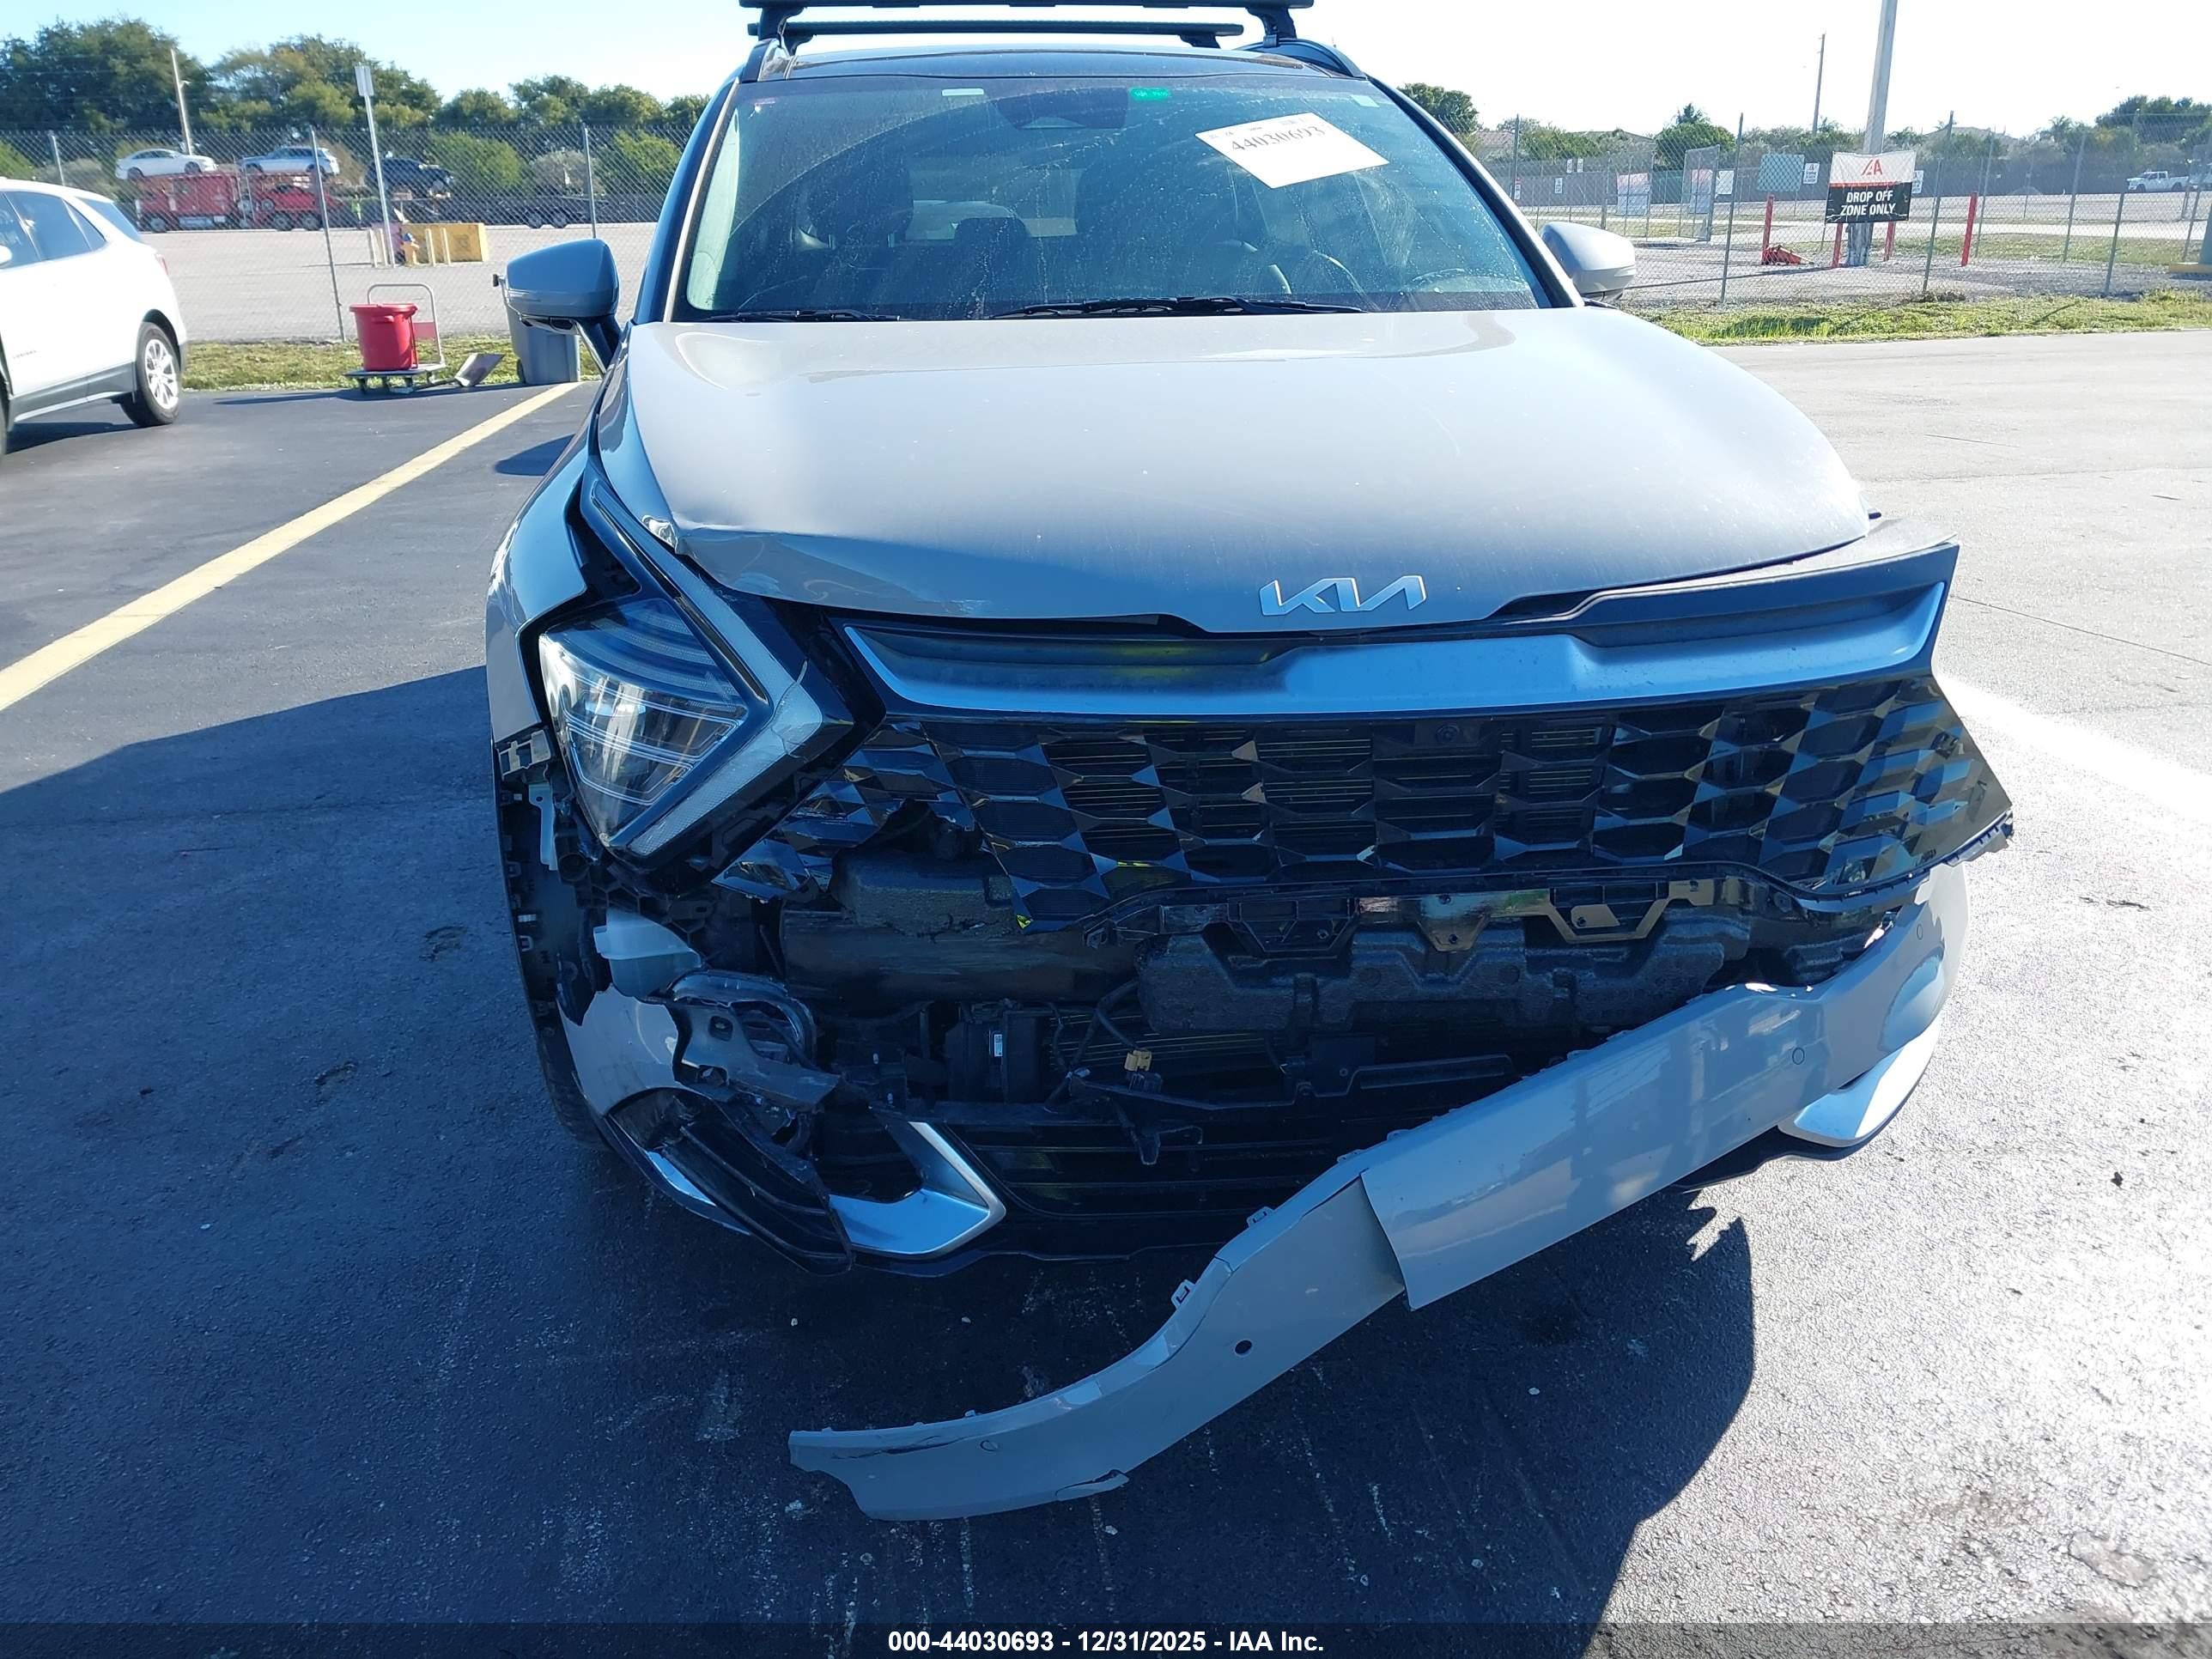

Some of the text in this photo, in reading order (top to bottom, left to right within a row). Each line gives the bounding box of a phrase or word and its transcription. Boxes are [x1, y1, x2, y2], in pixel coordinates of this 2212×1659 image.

[1846, 190, 1893, 203] DROP OFF
[1840, 203, 1896, 216] ZONE ONLY
